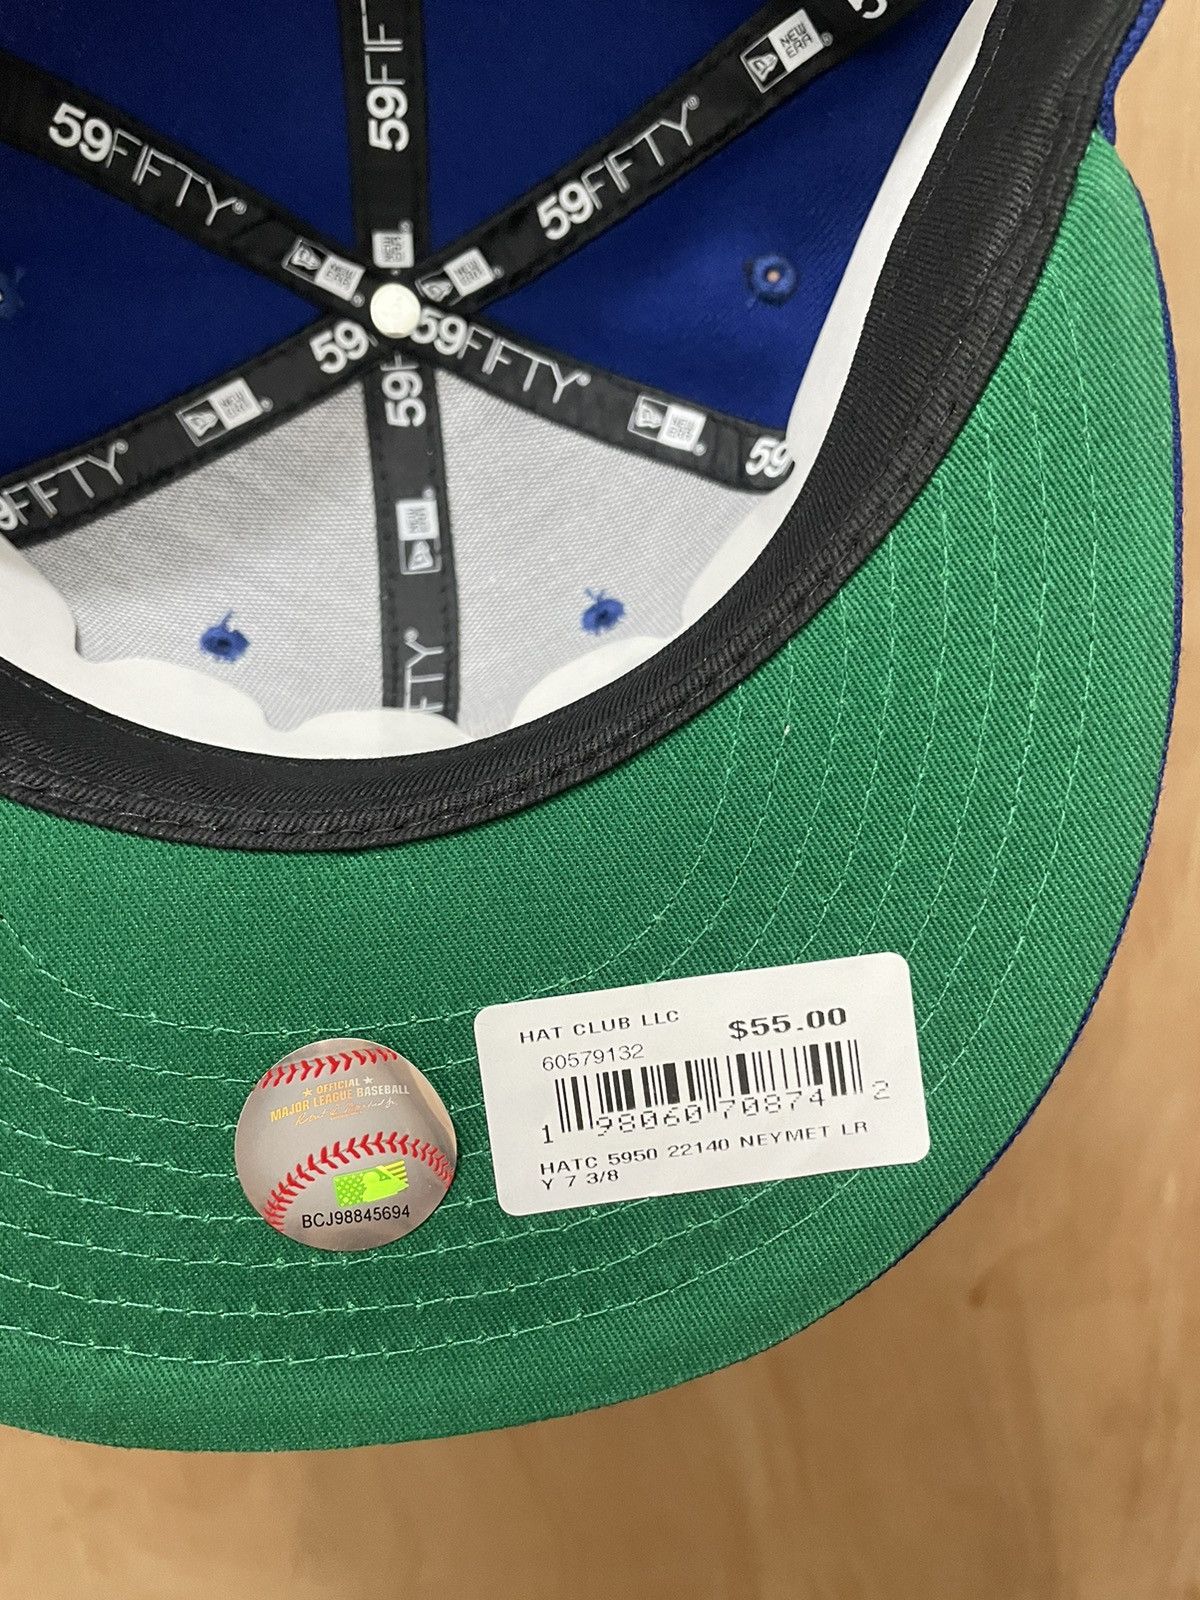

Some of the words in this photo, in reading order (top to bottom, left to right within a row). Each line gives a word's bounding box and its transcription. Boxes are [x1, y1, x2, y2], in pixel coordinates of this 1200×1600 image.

[780, 22, 807, 48] NEW
[785, 33, 813, 58] ERA
[519, 1026, 562, 1043] HAT
[573, 1016, 631, 1036] CLUB
[641, 1010, 679, 1026] LLC
[728, 1007, 847, 1041] $55.00
[542, 1043, 645, 1071] 60579132
[316, 1077, 361, 1095] OFFICIAL
[270, 1099, 309, 1122] MAJOR
[313, 1088, 353, 1107] LEAGUE
[356, 1084, 410, 1098] BASEBALL
[541, 1124, 554, 1144] 1
[872, 1080, 891, 1100] 2
[540, 1156, 598, 1175] HATC
[607, 1147, 658, 1166] 5950
[667, 1138, 730, 1158] 22140
[740, 1125, 831, 1148] NEYMET
[841, 1120, 868, 1136] LR
[541, 1178, 553, 1190] Y
[566, 1174, 577, 1188] 7
[586, 1168, 619, 1185] 3/8
[301, 1204, 411, 1229] BCJ98845694
